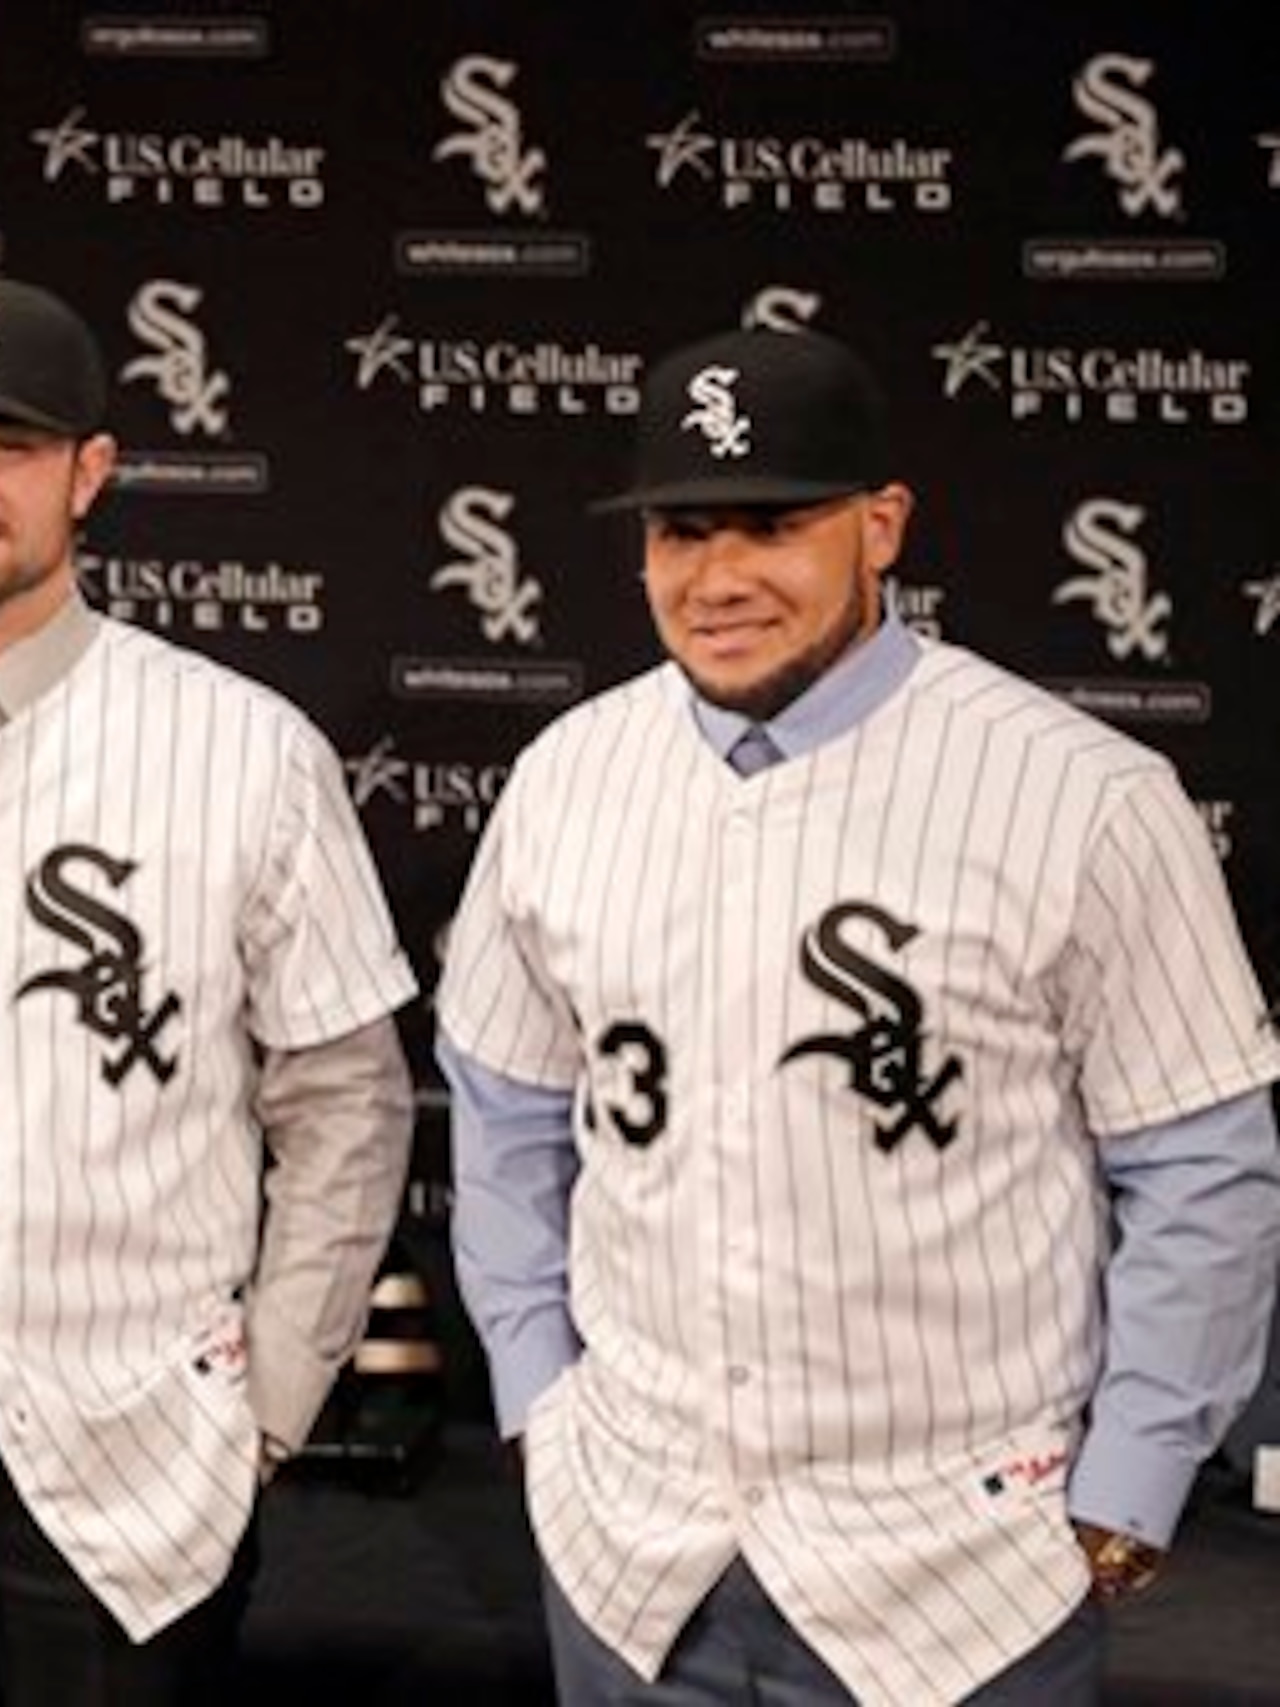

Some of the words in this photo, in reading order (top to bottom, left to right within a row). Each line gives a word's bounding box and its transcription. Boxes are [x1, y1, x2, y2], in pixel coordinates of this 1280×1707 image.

[169, 137, 323, 176] Cellular
[789, 140, 951, 179] Cellular
[108, 179, 323, 207] FIELD
[724, 183, 950, 209] FIELD
[484, 344, 642, 383] Cellular
[1081, 350, 1248, 391] Cellular
[420, 385, 640, 413] FIELD
[1012, 392, 1247, 422] FIELD
[169, 562, 322, 601] Cellular
[108, 602, 320, 630] FIELD
[14, 845, 180, 1088] Sox
[776, 901, 963, 1155] Sox
[584, 1021, 667, 1148] 3
